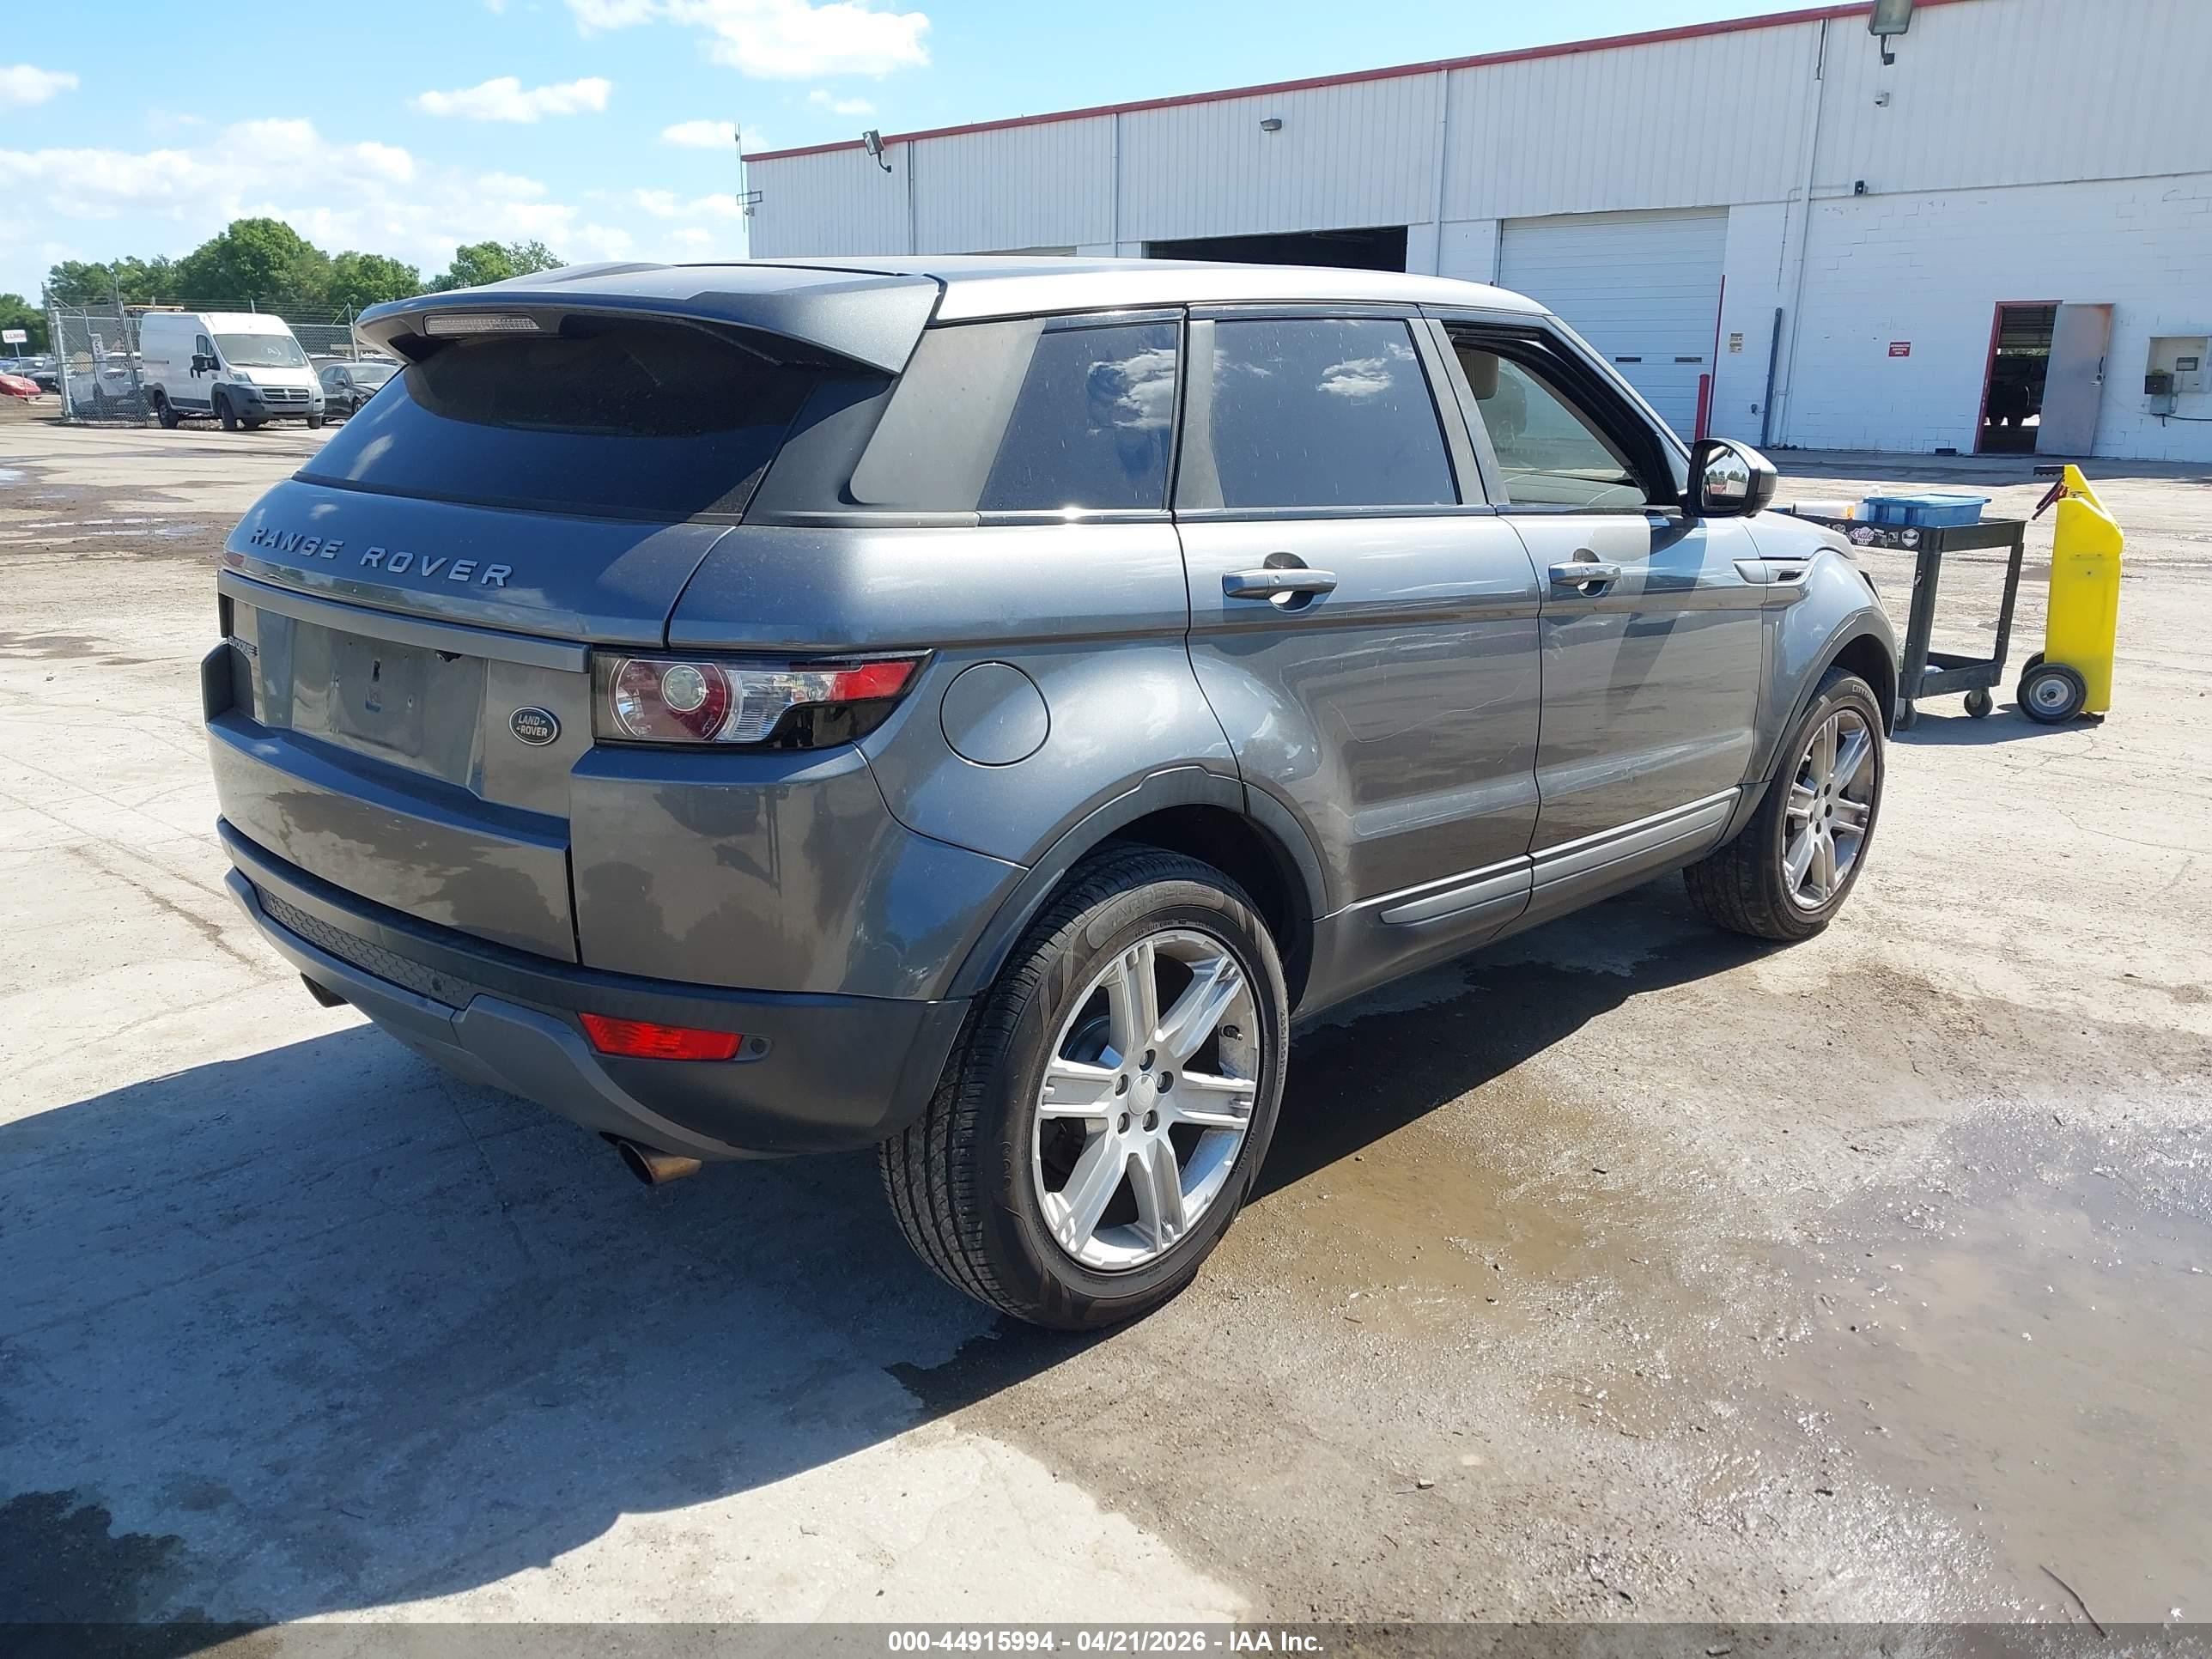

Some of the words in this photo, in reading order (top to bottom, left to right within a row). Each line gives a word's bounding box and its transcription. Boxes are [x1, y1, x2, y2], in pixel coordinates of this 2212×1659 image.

[249, 526, 345, 560] RANGE
[360, 545, 513, 587] ROVER
[517, 714, 541, 726] LAND
[520, 725, 549, 738] ROVER
